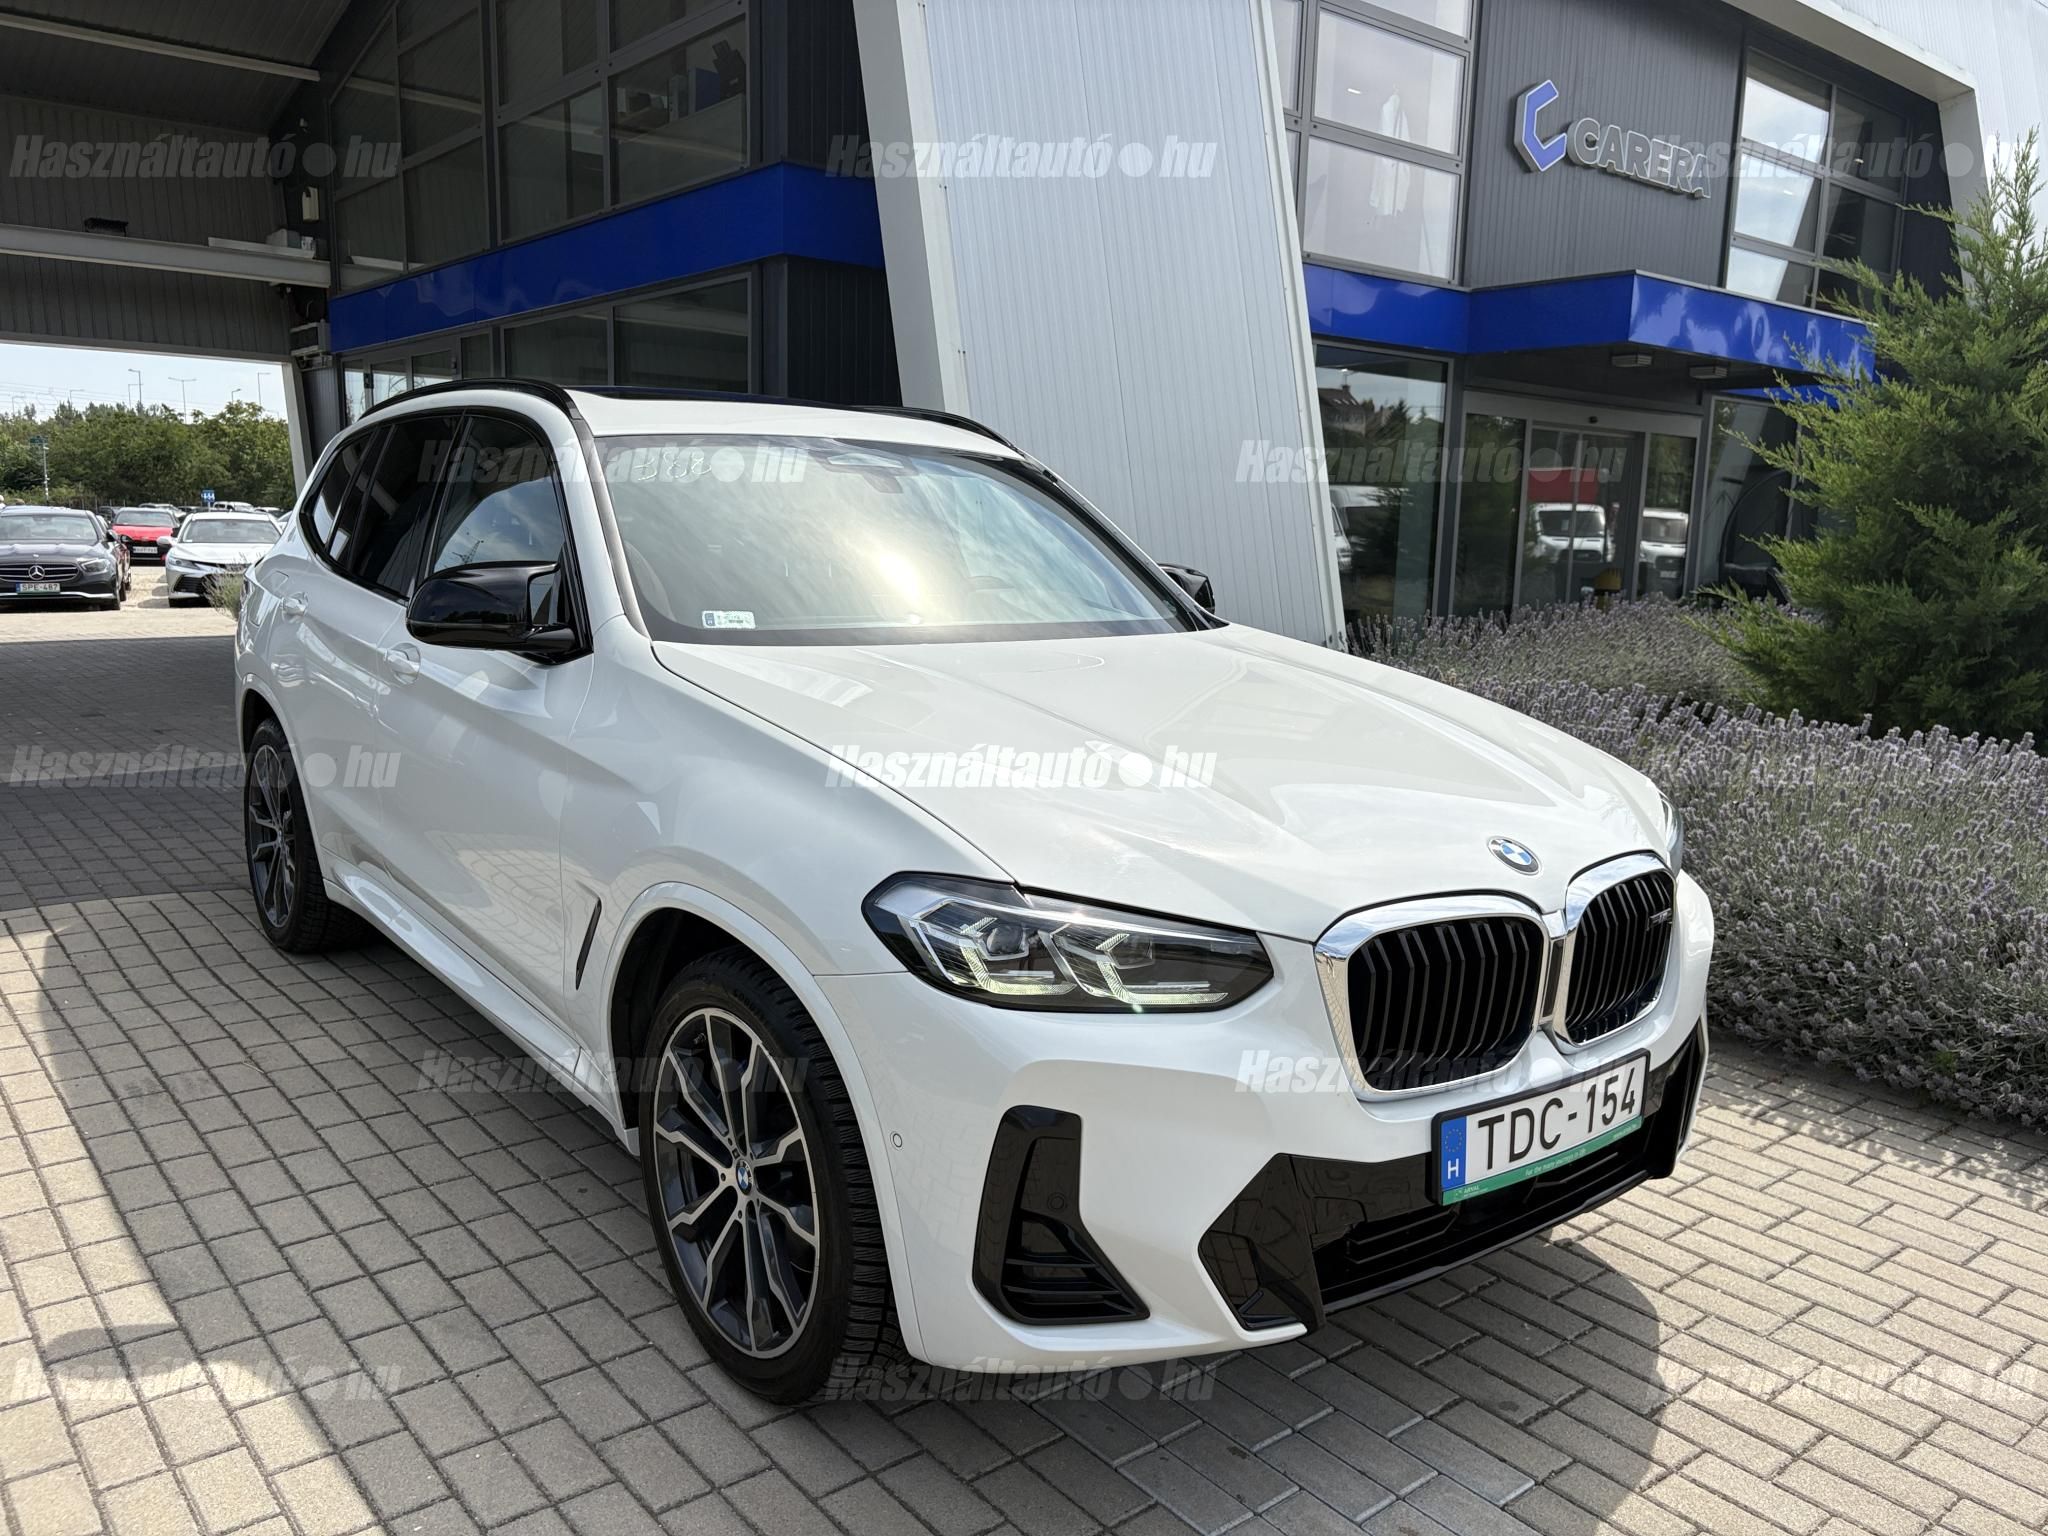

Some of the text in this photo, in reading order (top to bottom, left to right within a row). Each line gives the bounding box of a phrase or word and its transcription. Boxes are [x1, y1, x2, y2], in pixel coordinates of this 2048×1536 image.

[1570, 117, 1712, 199] CARERA
[1478, 1067, 1636, 1170] TDC-154
[1447, 1158, 1460, 1180] H
